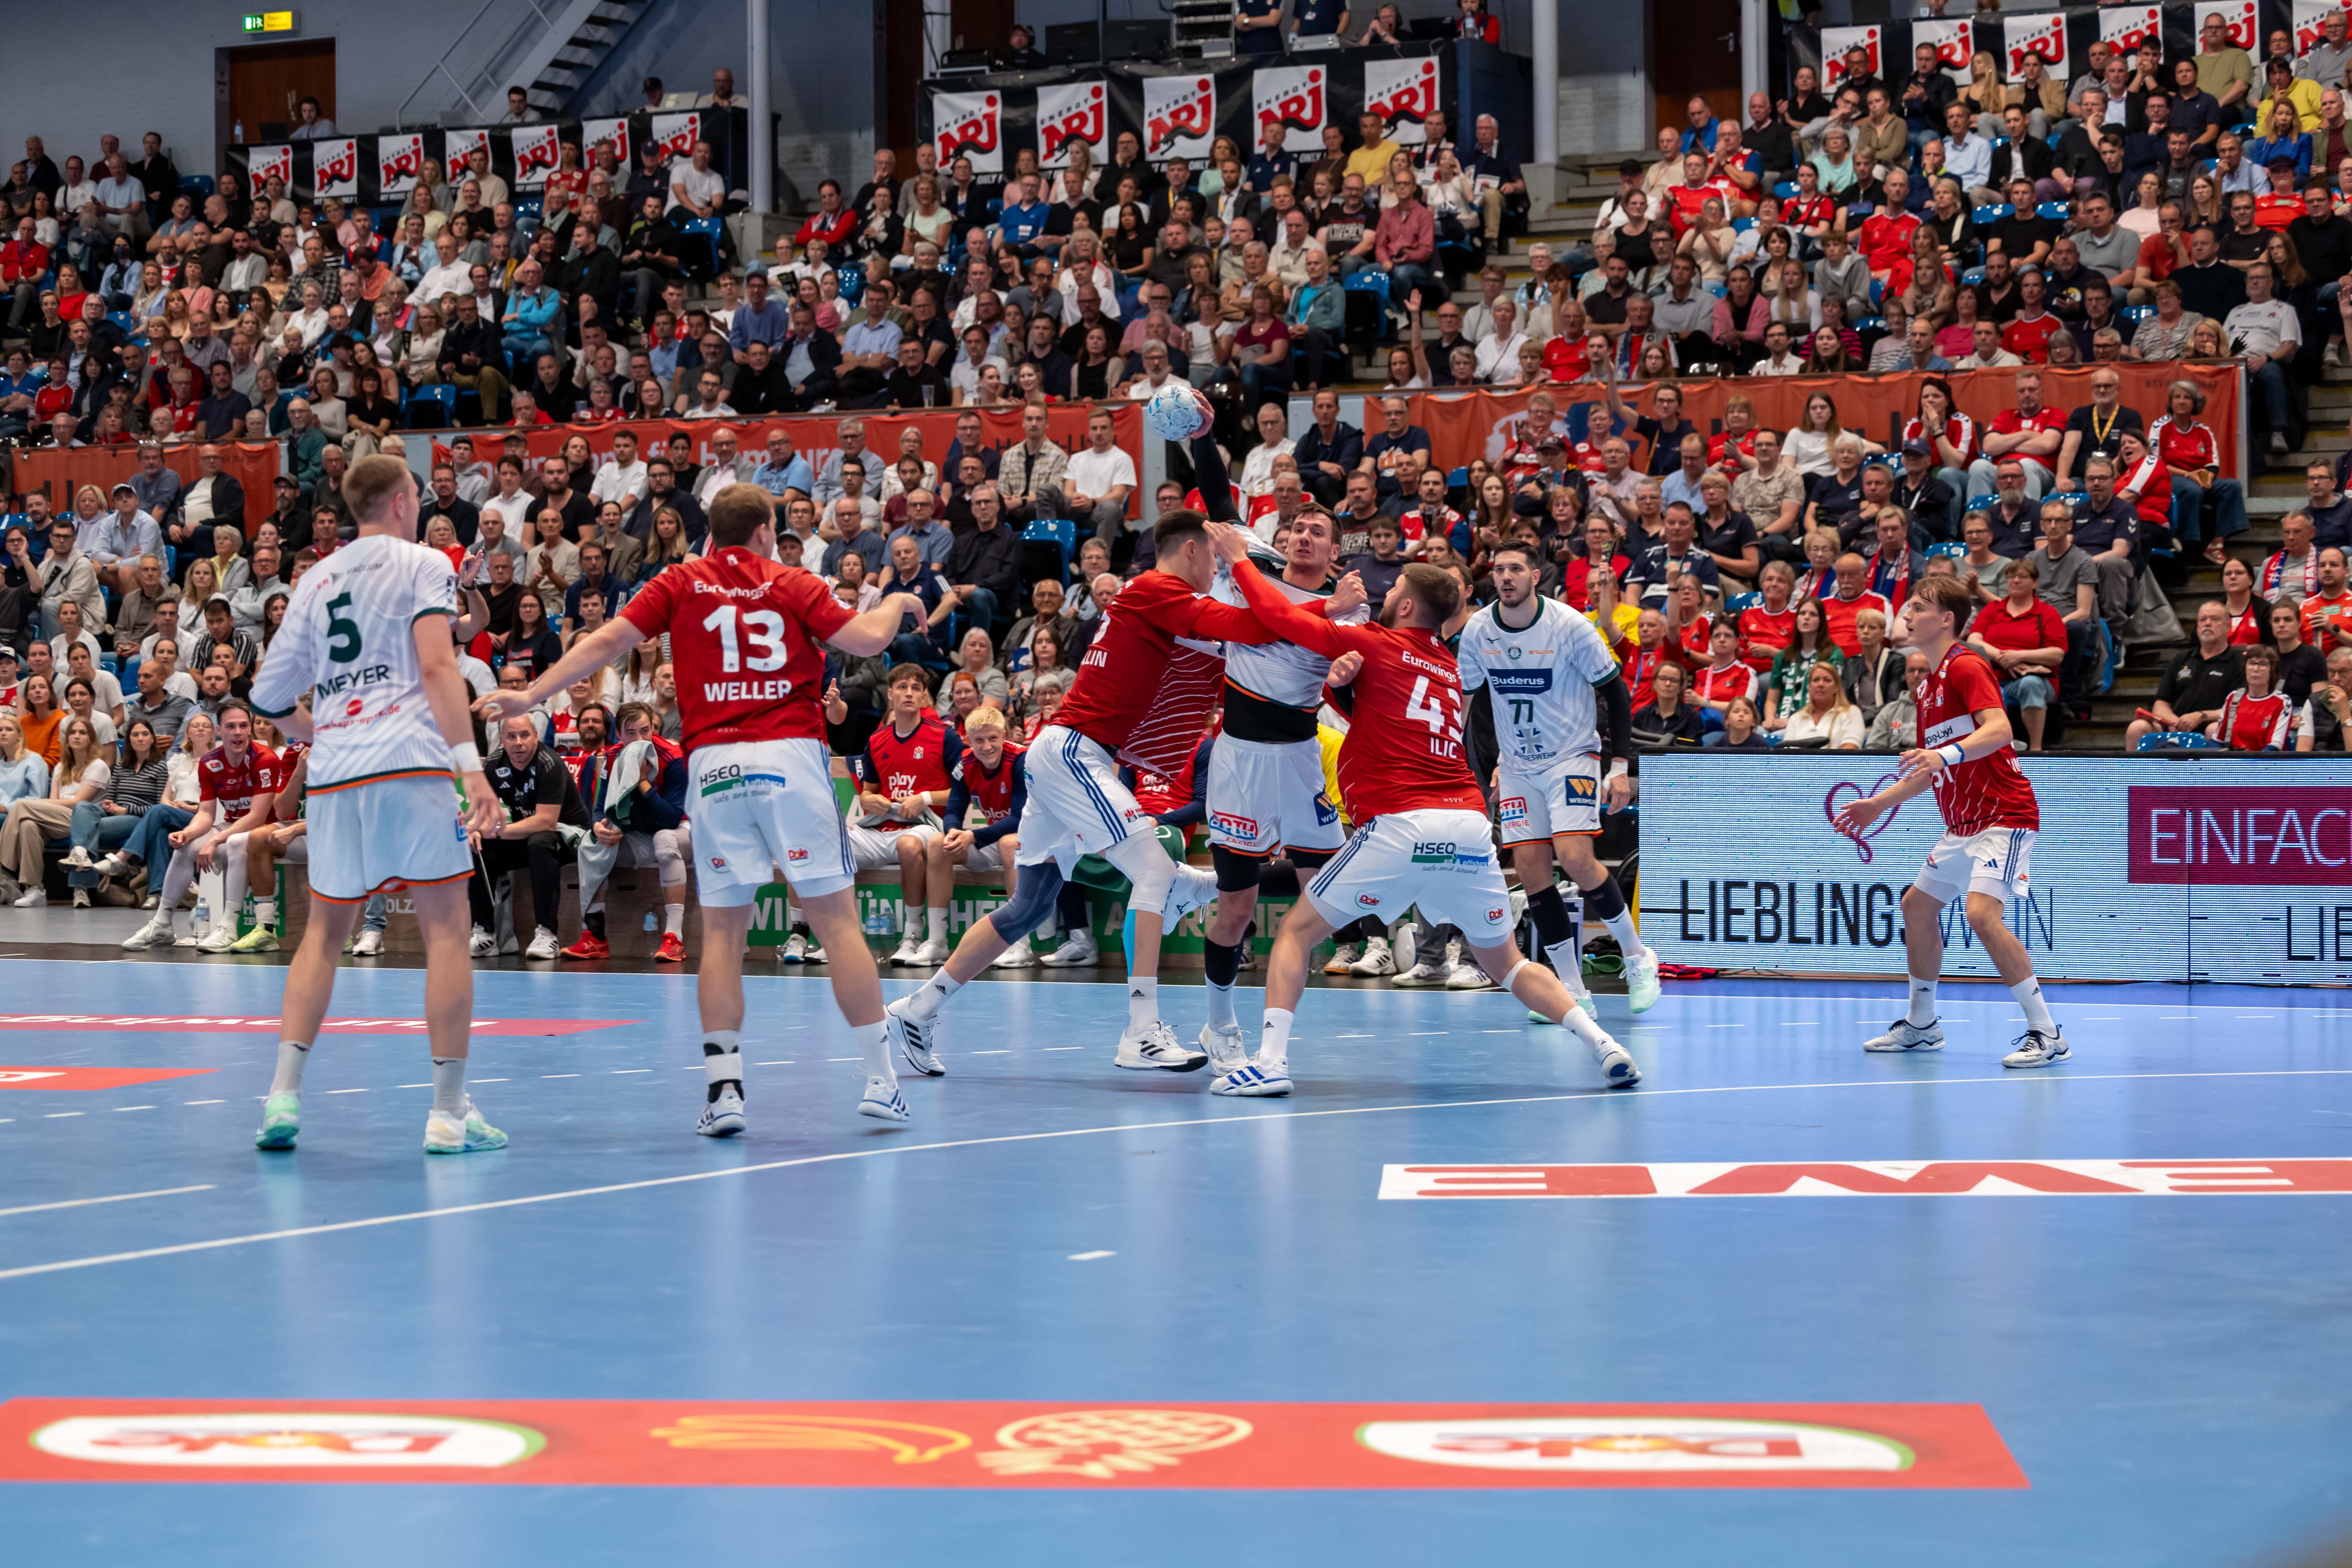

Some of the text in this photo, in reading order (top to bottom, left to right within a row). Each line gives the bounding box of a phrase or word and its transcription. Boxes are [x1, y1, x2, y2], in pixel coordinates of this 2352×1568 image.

[2009, 26, 2050, 48] ENERGY
[1257, 82, 1307, 109] ENERGY
[1368, 74, 1418, 102] ENERGY
[1041, 98, 1089, 125] ENERGY
[1148, 91, 1196, 118] ENERGY
[1148, 78, 1211, 154] NRJ
[1258, 69, 1321, 147] NRJ
[938, 107, 982, 132] ENERGY
[938, 95, 997, 168] NRJ
[1041, 85, 1103, 162] NRJ
[382, 137, 421, 187] NRJ
[517, 128, 558, 178] NRJ
[317, 142, 354, 192] NRJ
[694, 581, 764, 600] Eurowings
[327, 592, 362, 662] 5
[703, 605, 787, 672] 13
[1402, 651, 1457, 682] Eurowings
[317, 664, 390, 699] MEYER
[704, 680, 792, 702] WELLER
[1491, 676, 1545, 686] Buderus
[1508, 699, 1534, 725] 77
[1430, 737, 1457, 759] ILIC
[700, 764, 744, 787] HSEQ
[888, 772, 917, 790] play
[1413, 842, 1457, 858] HSEQ
[2151, 808, 2352, 866] EINFAC
[788, 848, 808, 860] Dole
[1359, 895, 1380, 905] Dole
[1489, 908, 1504, 919] Dole
